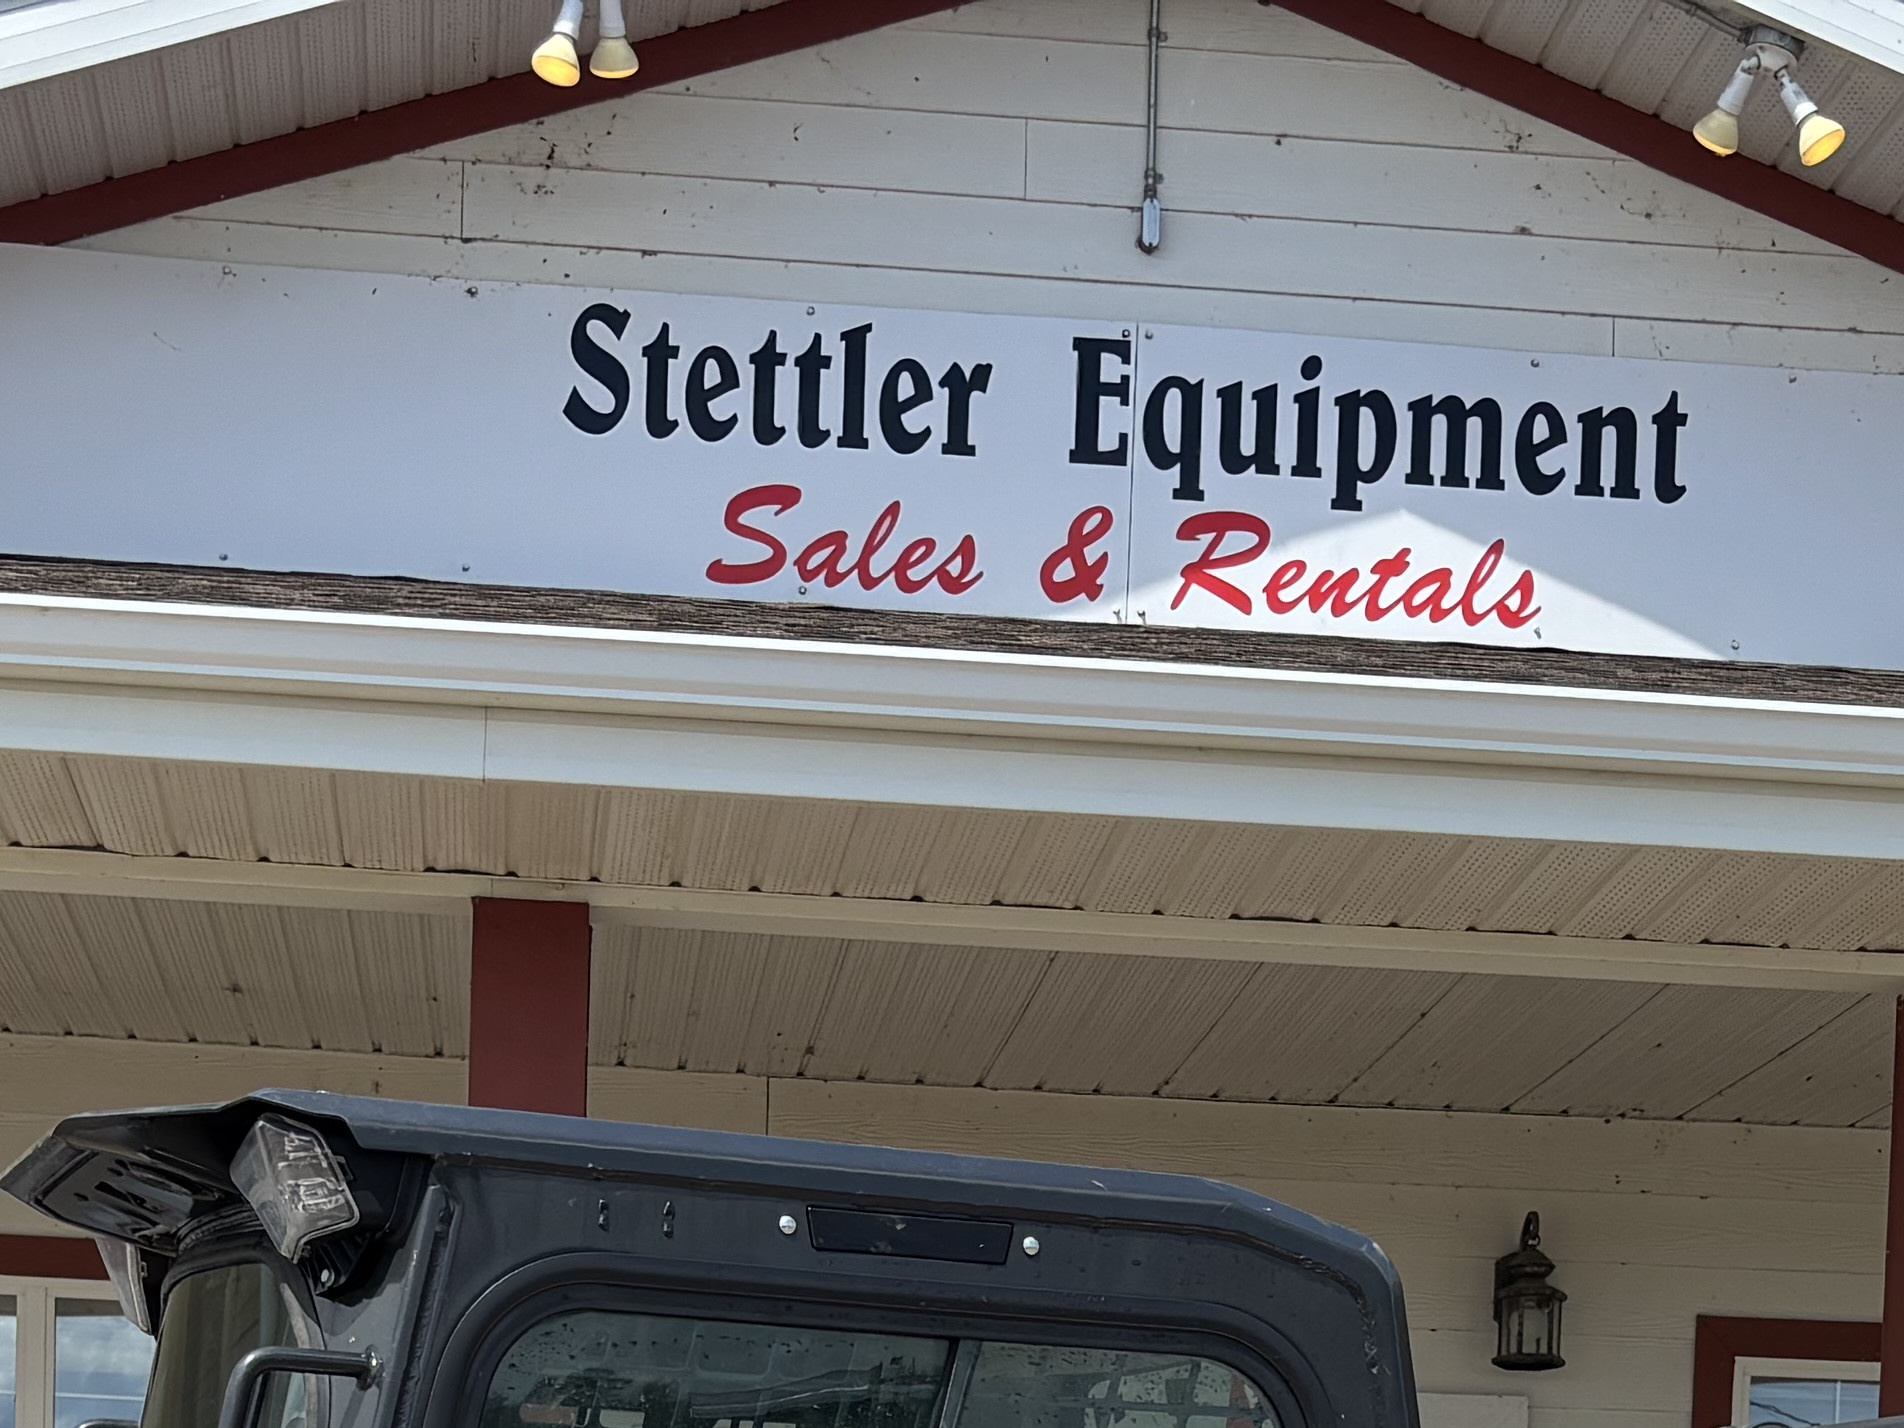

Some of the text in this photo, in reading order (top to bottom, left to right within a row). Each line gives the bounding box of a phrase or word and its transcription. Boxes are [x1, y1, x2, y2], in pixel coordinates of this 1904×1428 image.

[562, 303, 1690, 512] Stettler Equipment
[705, 485, 1542, 630] Sales & Rentals
